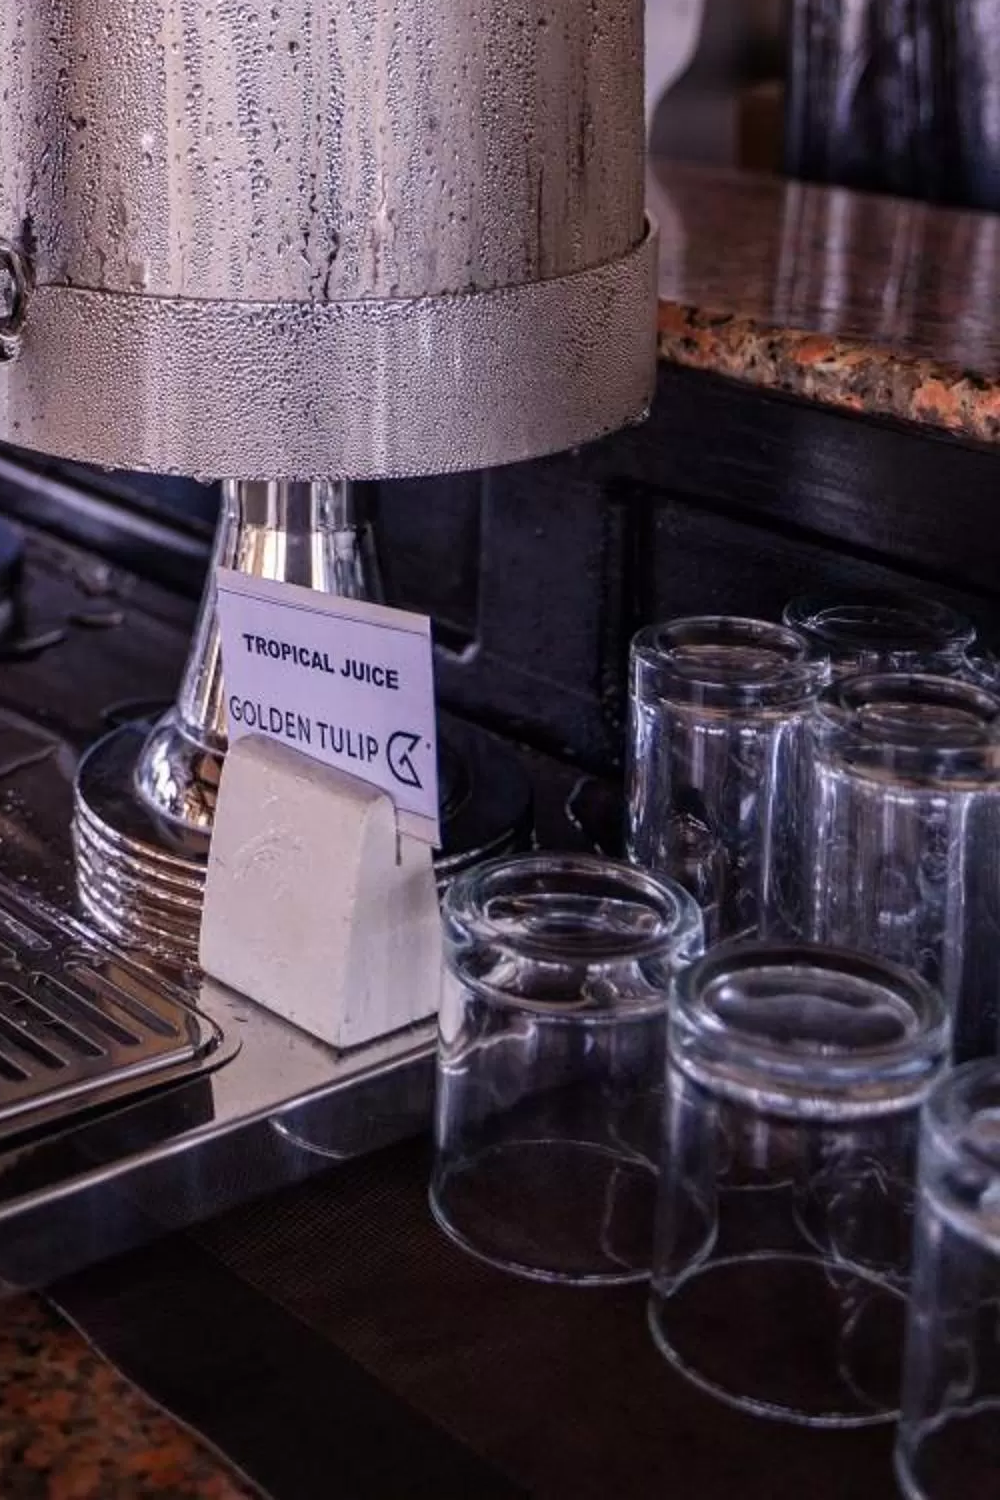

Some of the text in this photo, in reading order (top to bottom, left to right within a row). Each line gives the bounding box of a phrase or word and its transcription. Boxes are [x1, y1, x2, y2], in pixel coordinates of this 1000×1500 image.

[242, 633, 399, 690] TROPICAL JUICE
[229, 695, 379, 762] GOLDEN TULIP
